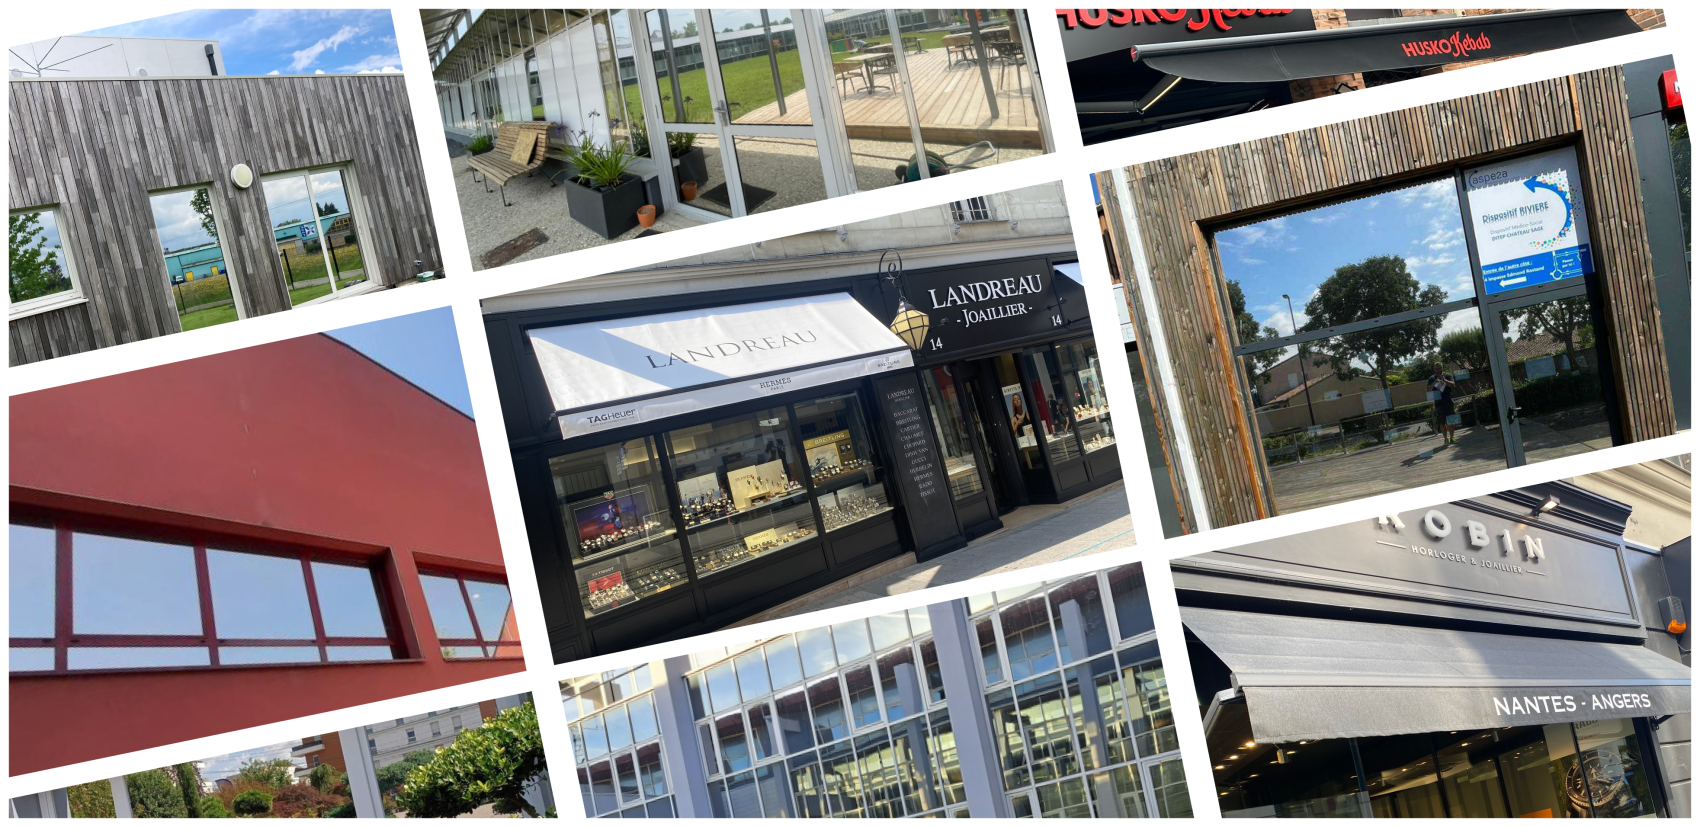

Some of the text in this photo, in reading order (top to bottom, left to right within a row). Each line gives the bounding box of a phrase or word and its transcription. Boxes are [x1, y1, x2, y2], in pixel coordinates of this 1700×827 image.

[1401, 31, 1492, 57] HUSKO Kebab
[1472, 170, 1508, 185] aspe2a
[1482, 208, 1518, 224] Dispositif
[928, 274, 1043, 310] LANDREAU
[962, 302, 1028, 328] JOAILLIER
[1051, 314, 1062, 327] 14
[644, 330, 817, 369] LANDREAU
[929, 337, 943, 351] 14
[814, 432, 845, 445] BREITLING
[1411, 545, 1467, 564] HORLOGER
[1471, 557, 1477, 566] &
[1493, 695, 1577, 716] NANTES
[1592, 693, 1651, 711] ANGERS
